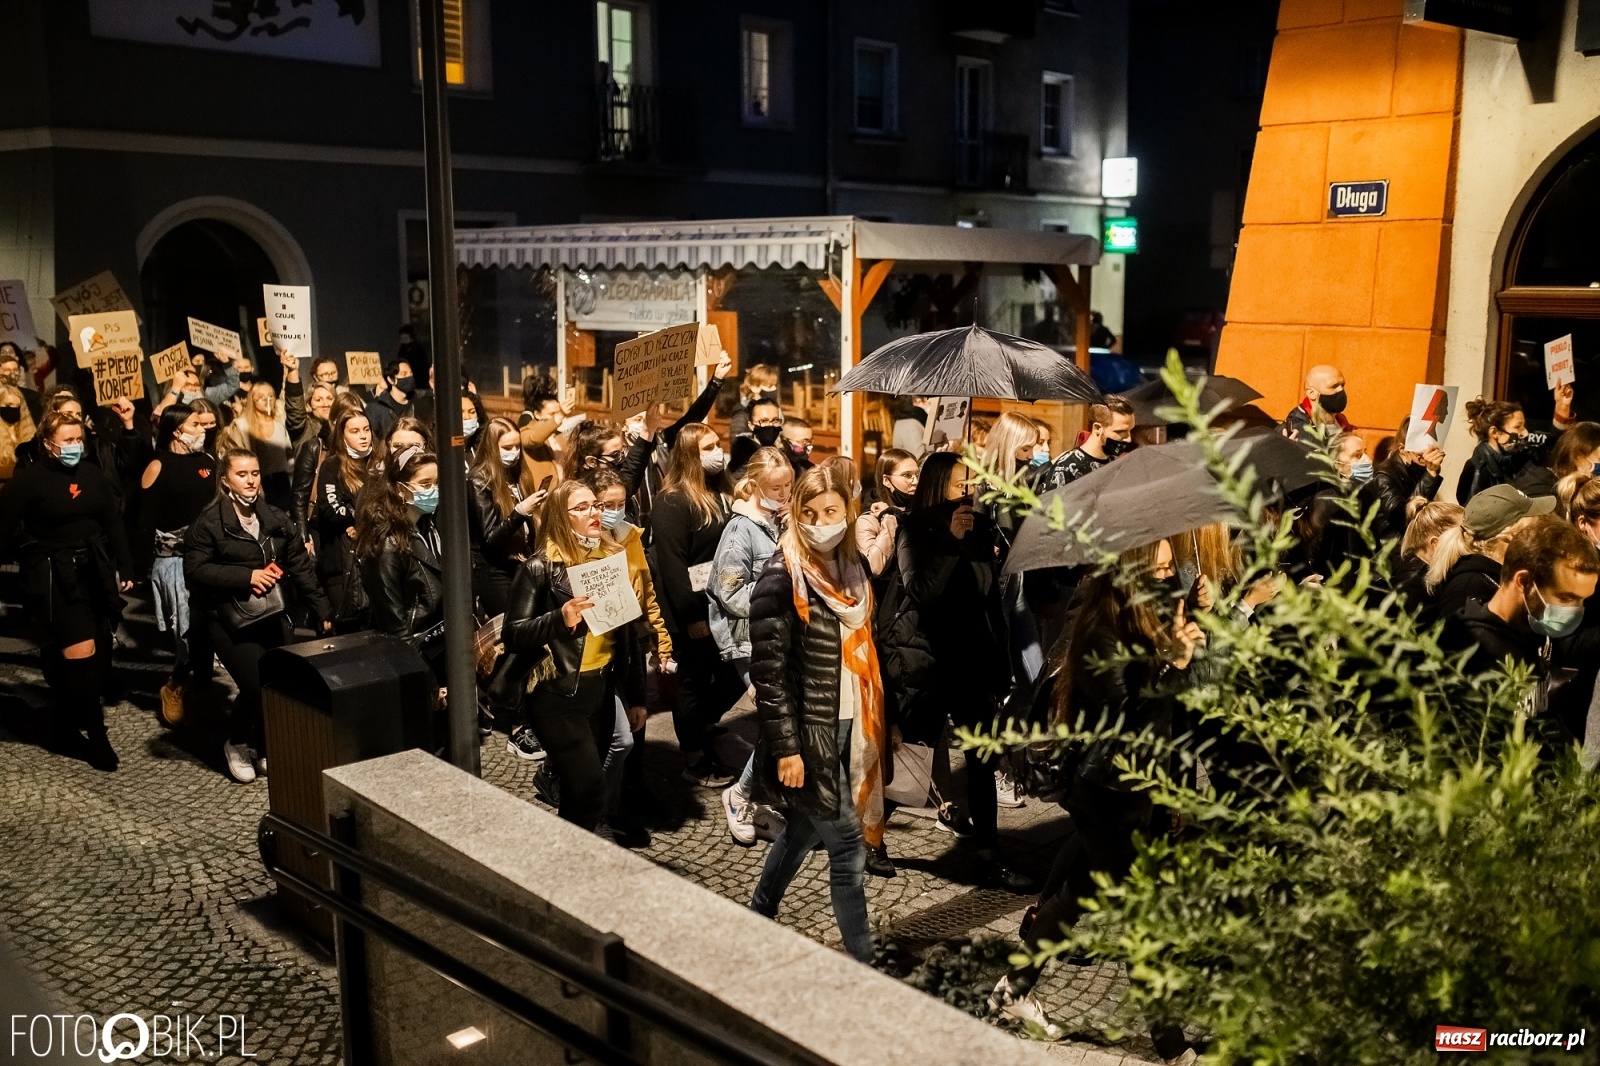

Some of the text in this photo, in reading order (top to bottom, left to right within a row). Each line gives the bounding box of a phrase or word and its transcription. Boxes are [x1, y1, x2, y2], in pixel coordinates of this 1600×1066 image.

[1336, 187, 1378, 212] Długa
[273, 291, 295, 299] MYŚLĘ
[159, 347, 184, 366] MÓJ
[616, 345, 641, 365] GDYBY
[644, 341, 654, 357] TO
[1551, 359, 1569, 373] KOBIET
[624, 381, 634, 391] TO
[581, 564, 611, 579] MILION NAS
[592, 572, 609, 582] TERAZ
